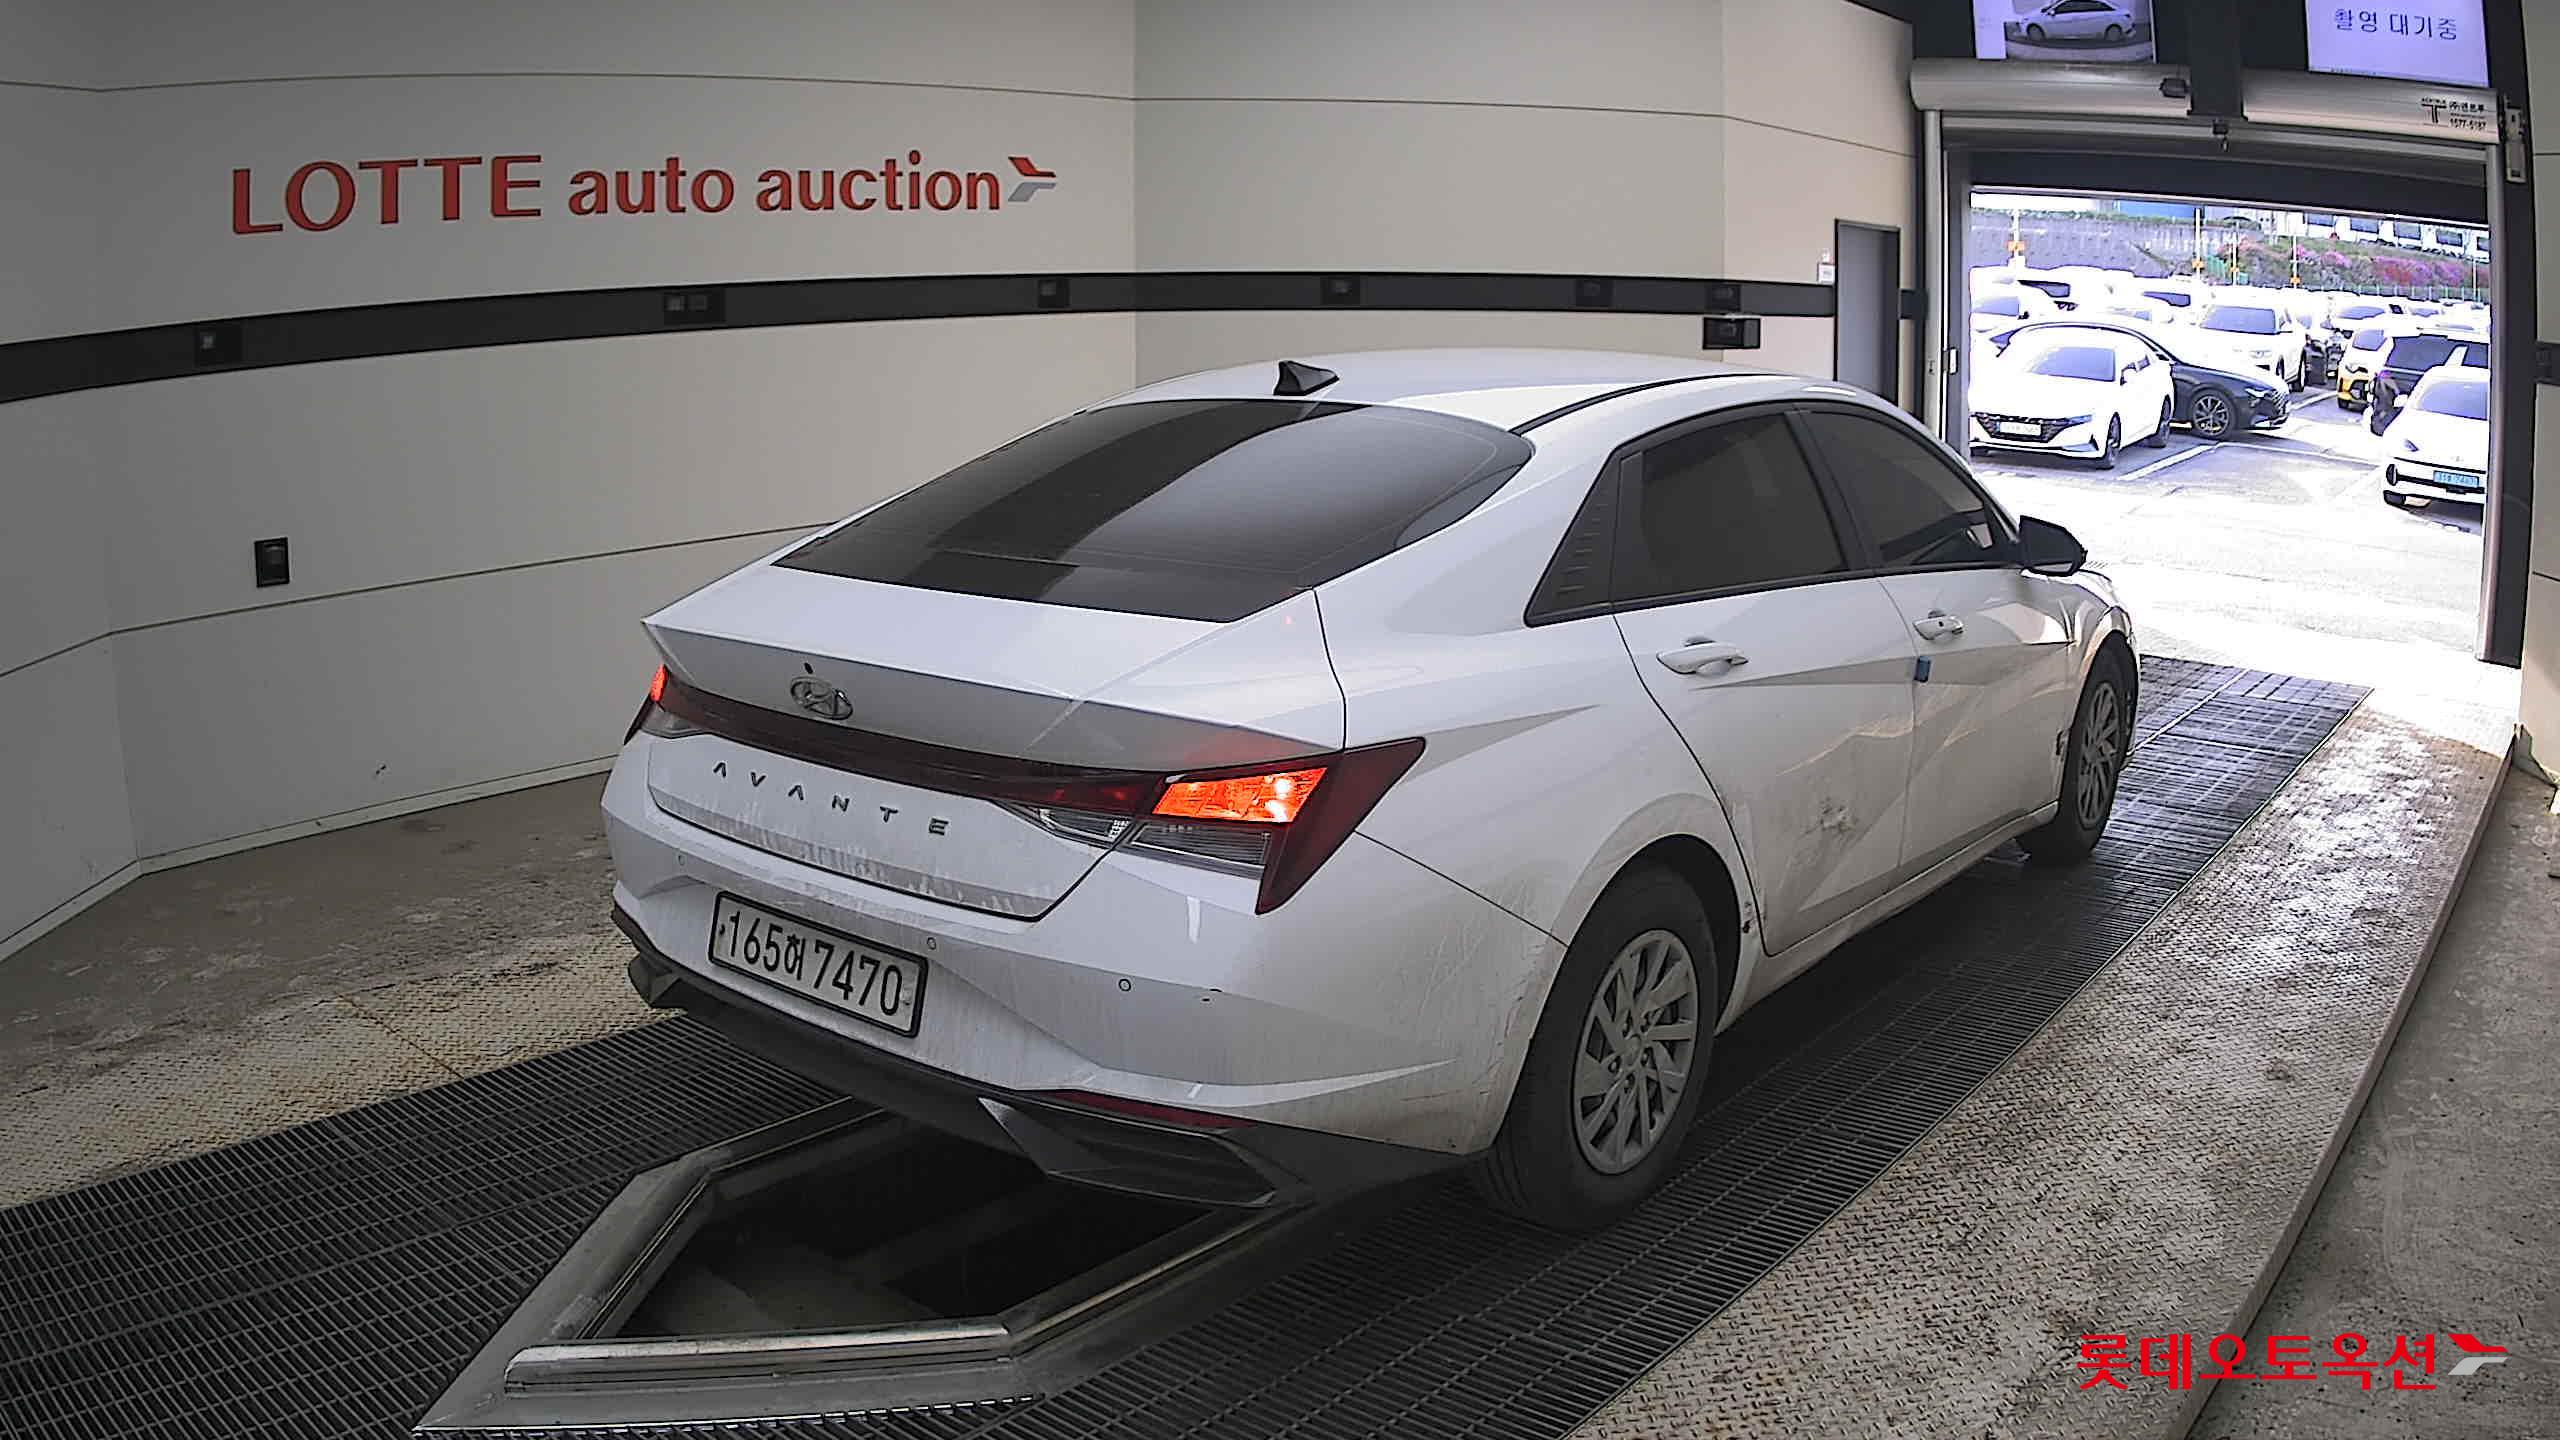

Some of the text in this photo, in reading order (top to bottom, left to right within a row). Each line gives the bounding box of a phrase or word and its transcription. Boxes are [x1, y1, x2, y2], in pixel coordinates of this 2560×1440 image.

[2335, 8, 2457, 41] 촬영 대기중
[232, 150, 1001, 235] LOTTE auto auction
[712, 761, 950, 836] AVANTE
